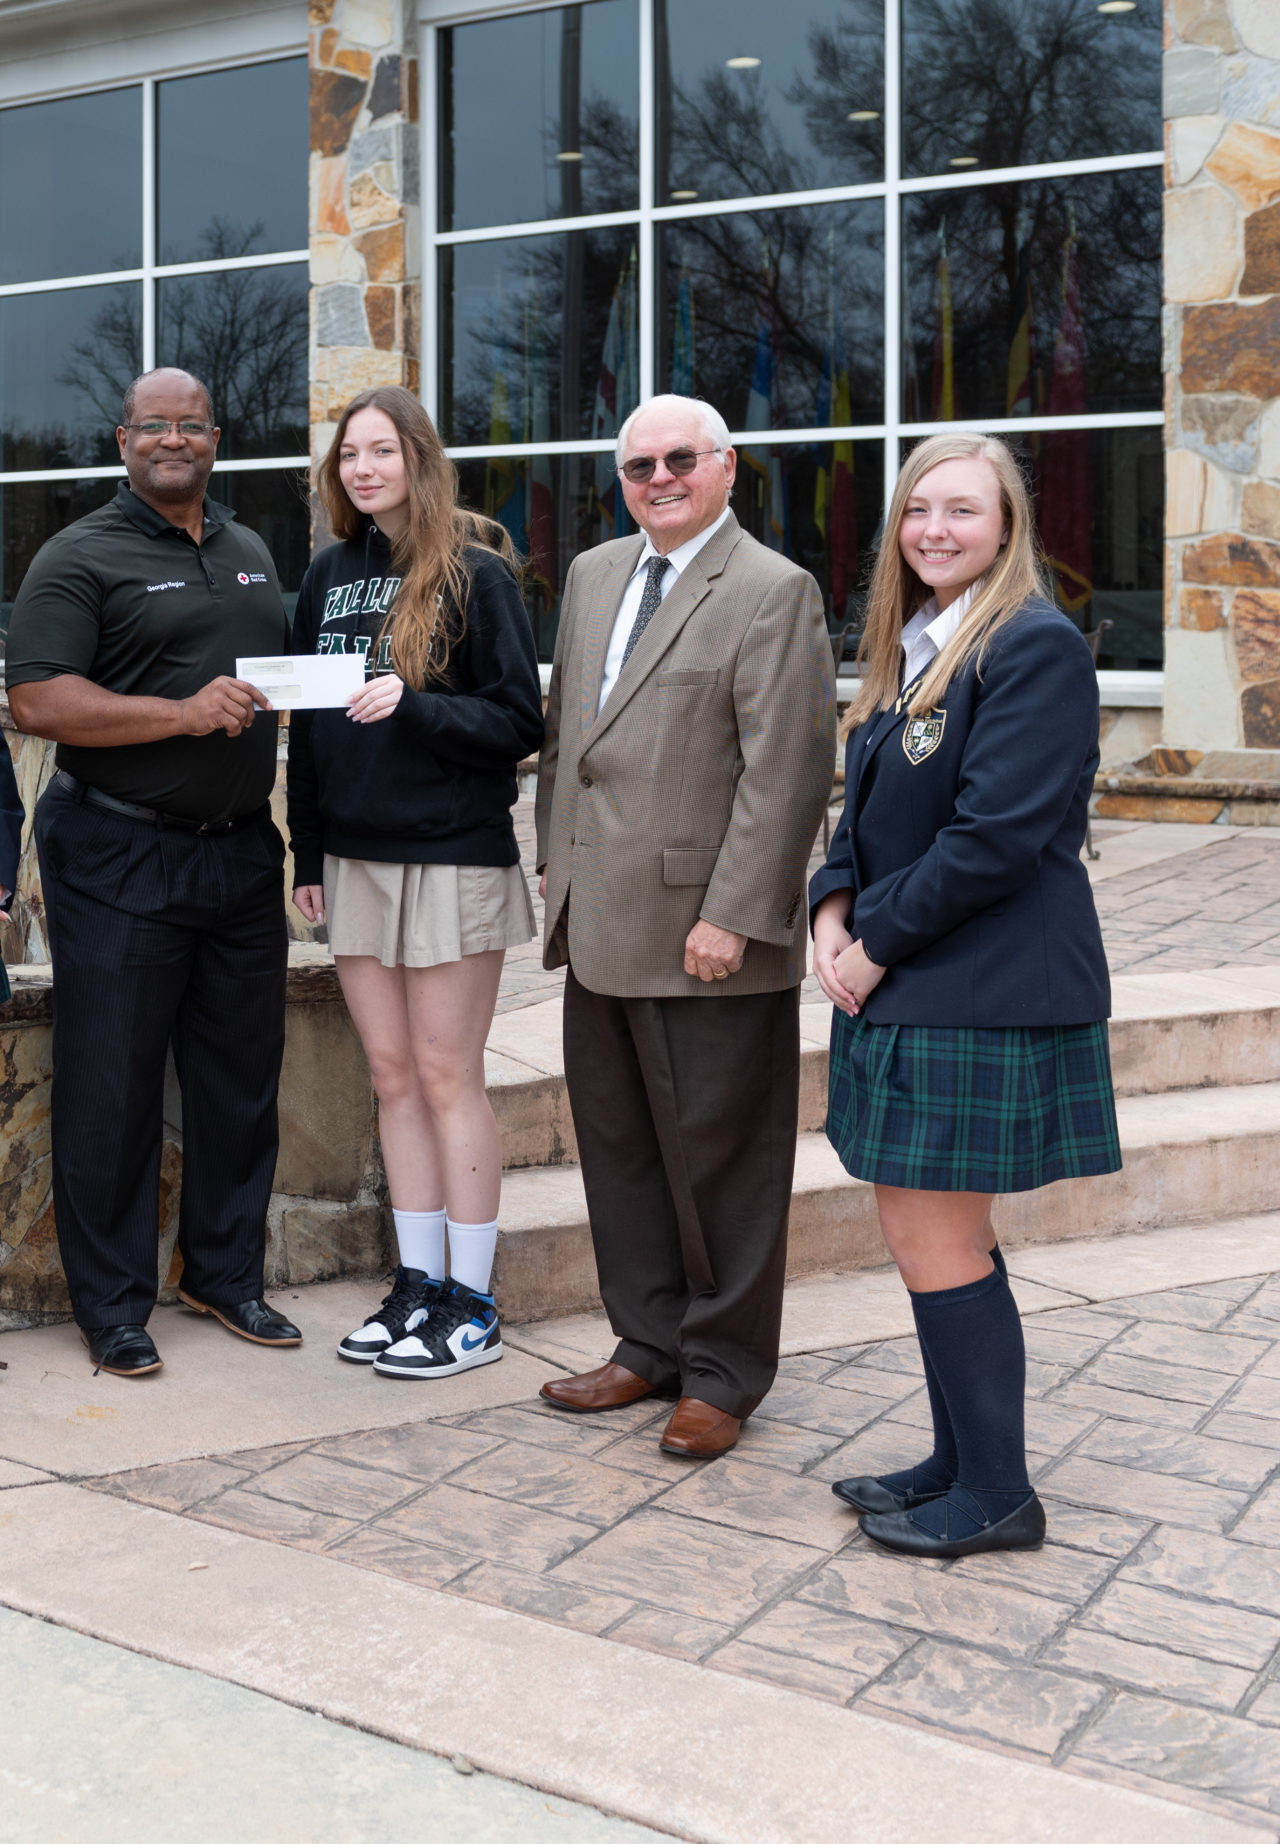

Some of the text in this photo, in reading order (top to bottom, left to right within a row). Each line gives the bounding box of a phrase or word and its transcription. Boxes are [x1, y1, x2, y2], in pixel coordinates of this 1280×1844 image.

[146, 580, 186, 592] Georgia Region
[321, 577, 402, 627] TALLU
[316, 633, 396, 673] FALL
